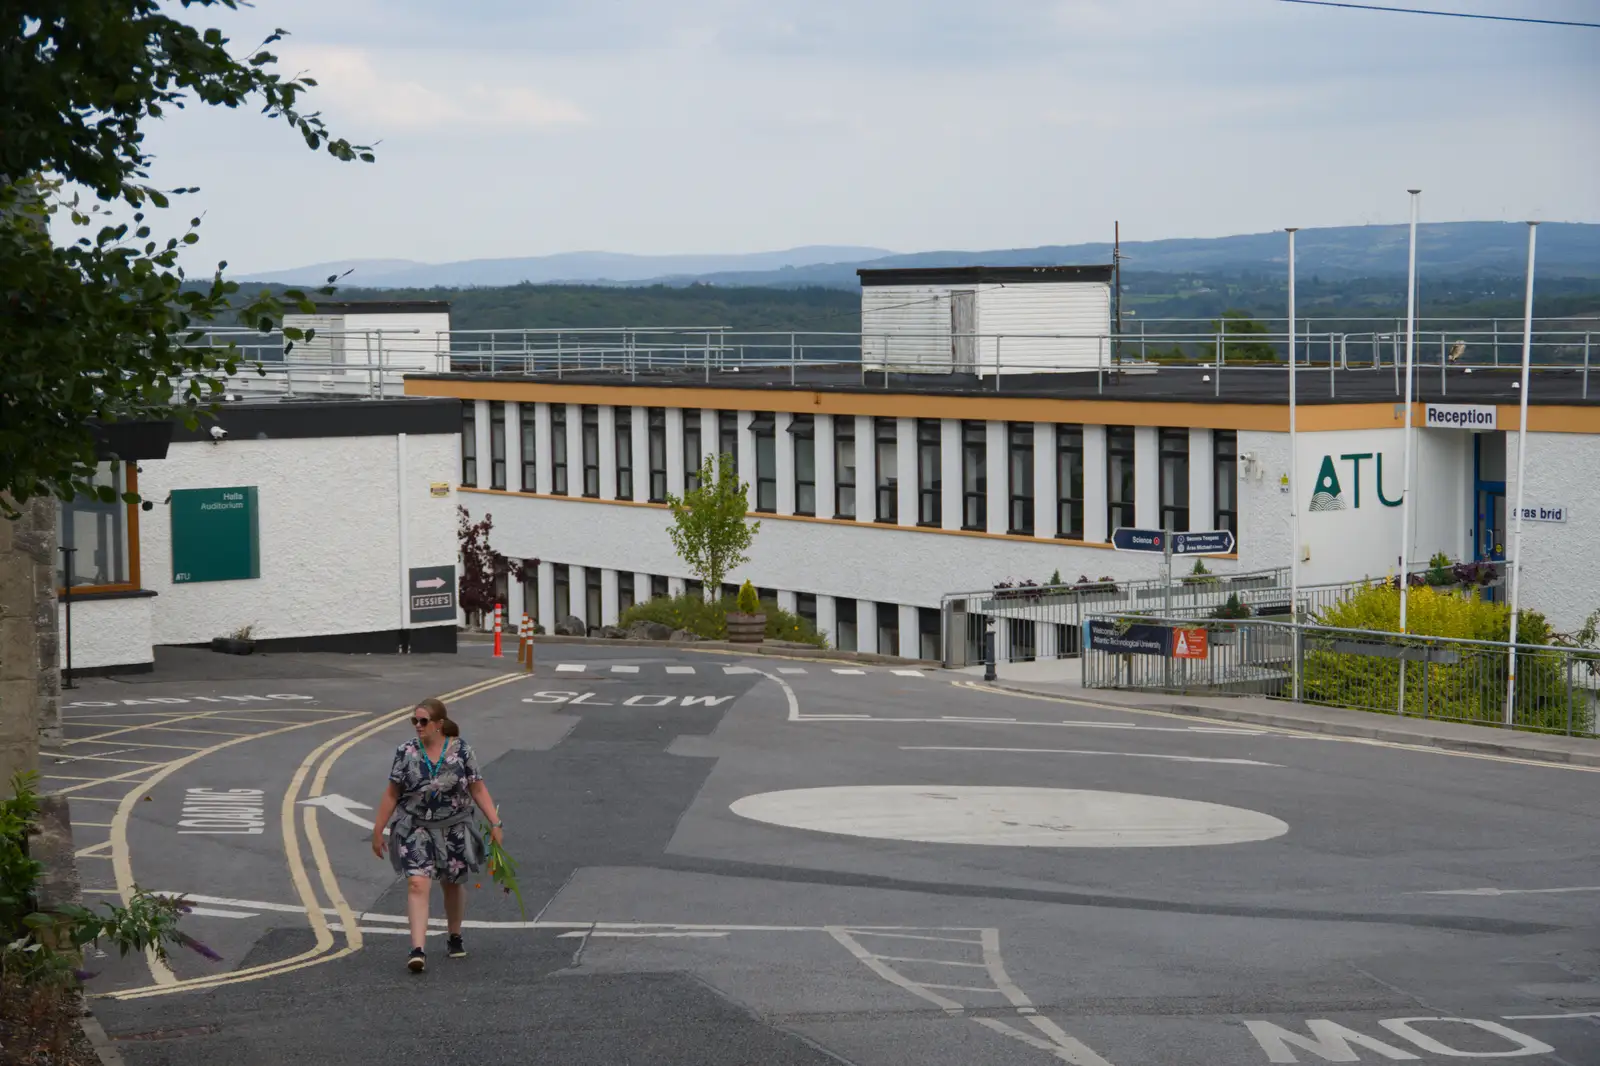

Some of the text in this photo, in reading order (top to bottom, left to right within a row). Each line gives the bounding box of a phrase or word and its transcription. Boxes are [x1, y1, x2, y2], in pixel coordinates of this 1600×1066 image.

[1428, 408, 1493, 426] Reception
[1309, 452, 1404, 512] ATU
[200, 502, 244, 510] Auditorium
[1540, 507, 1562, 520] brid
[1132, 536, 1152, 544] Science
[175, 572, 191, 581] ATU
[414, 596, 449, 607] JESSIE'S
[1093, 636, 1161, 650] Atlantic Technological University
[61, 693, 314, 708] OADING
[521, 690, 735, 707] SLOW
